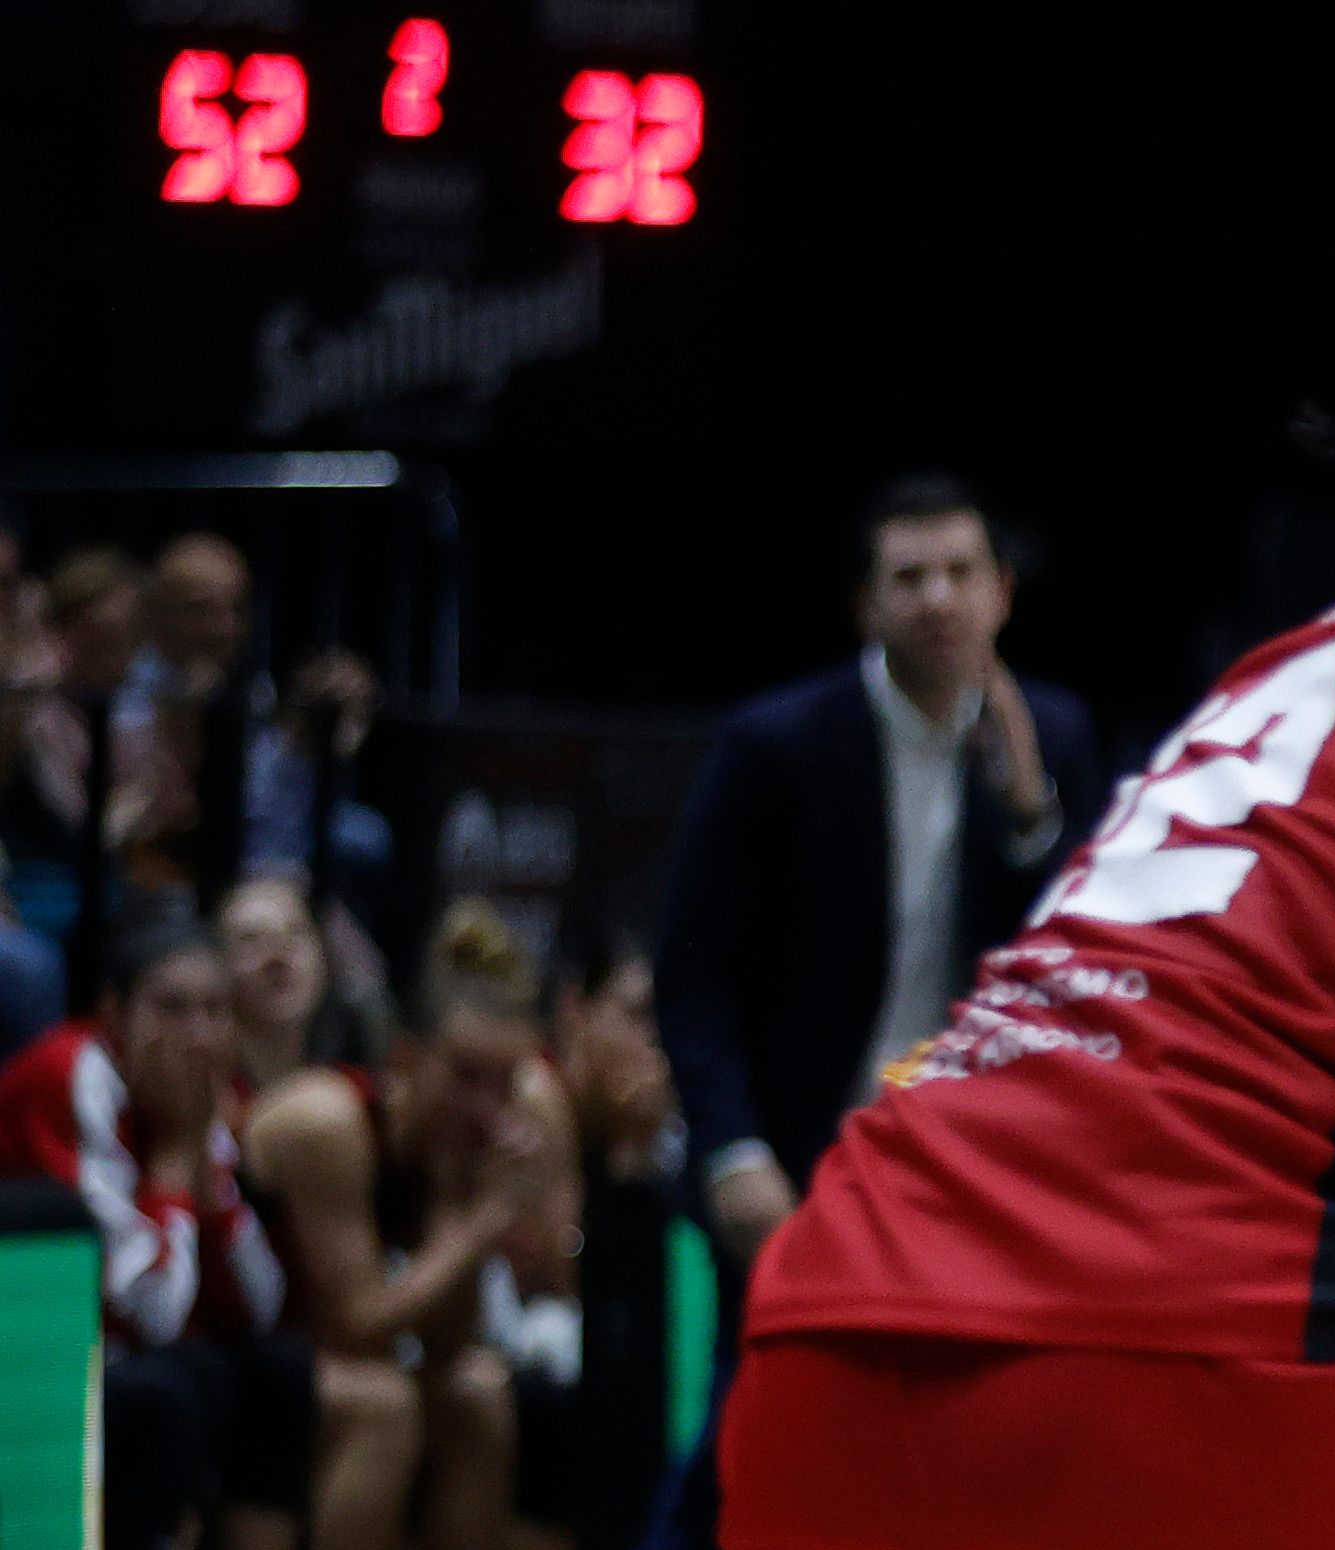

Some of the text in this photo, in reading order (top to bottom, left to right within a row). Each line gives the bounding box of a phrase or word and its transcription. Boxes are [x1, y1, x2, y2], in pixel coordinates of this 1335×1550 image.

[159, 48, 309, 207] 52
[382, 18, 450, 137] 2
[559, 69, 705, 226] 32
